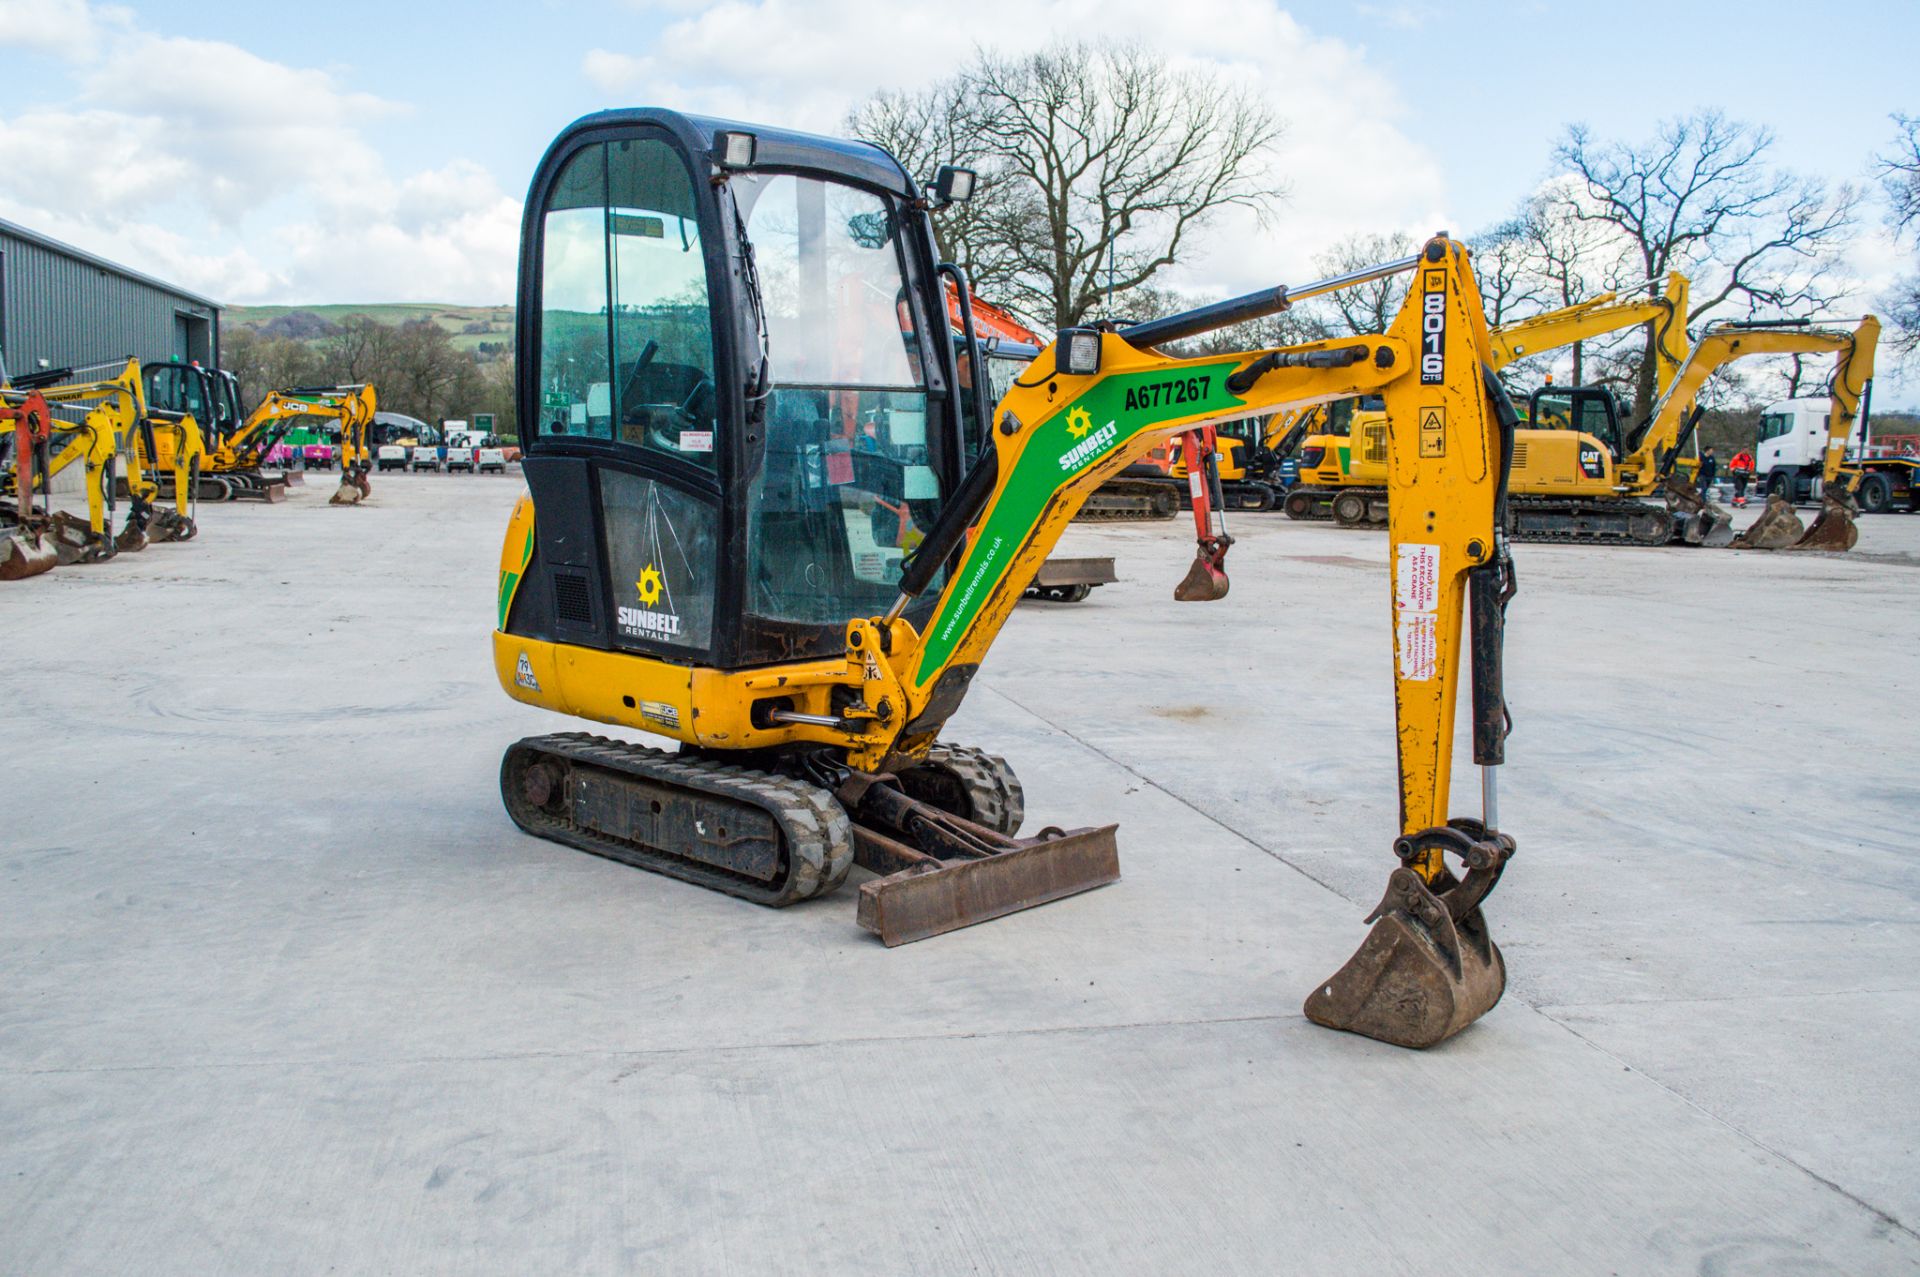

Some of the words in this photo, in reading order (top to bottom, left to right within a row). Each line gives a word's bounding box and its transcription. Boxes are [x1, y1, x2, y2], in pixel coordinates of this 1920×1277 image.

[1422, 294, 1446, 374] 8016
[282, 402, 308, 412] JCB
[1125, 376, 1211, 412] A677267
[1058, 420, 1118, 471] SUNBELT
[1072, 439, 1114, 472] RENTALS
[1581, 451, 1600, 463] CAT
[1412, 556, 1418, 566] AS
[1427, 556, 1433, 567] DO
[941, 536, 1003, 640] www.sunbeltrentals.co.uk
[618, 606, 679, 634] SUNBELT
[625, 626, 670, 641] RENTALS
